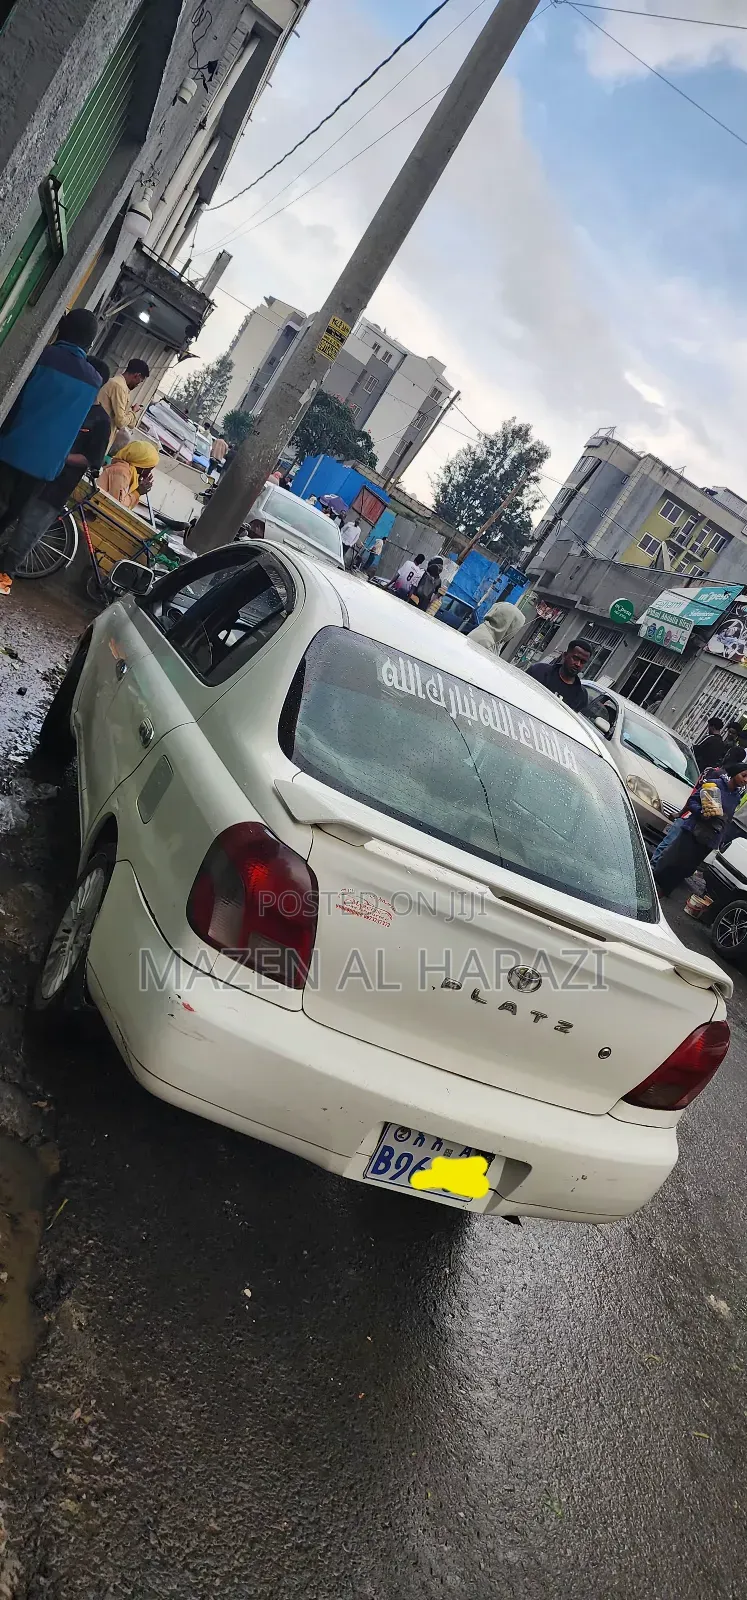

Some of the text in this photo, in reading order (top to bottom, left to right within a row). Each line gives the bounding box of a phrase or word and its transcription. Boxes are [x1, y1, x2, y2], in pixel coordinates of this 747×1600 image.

[406, 571, 414, 582] 8
[381, 656, 426, 700] الله
[479, 698, 518, 740] الله
[440, 976, 574, 1034] PLATZ
